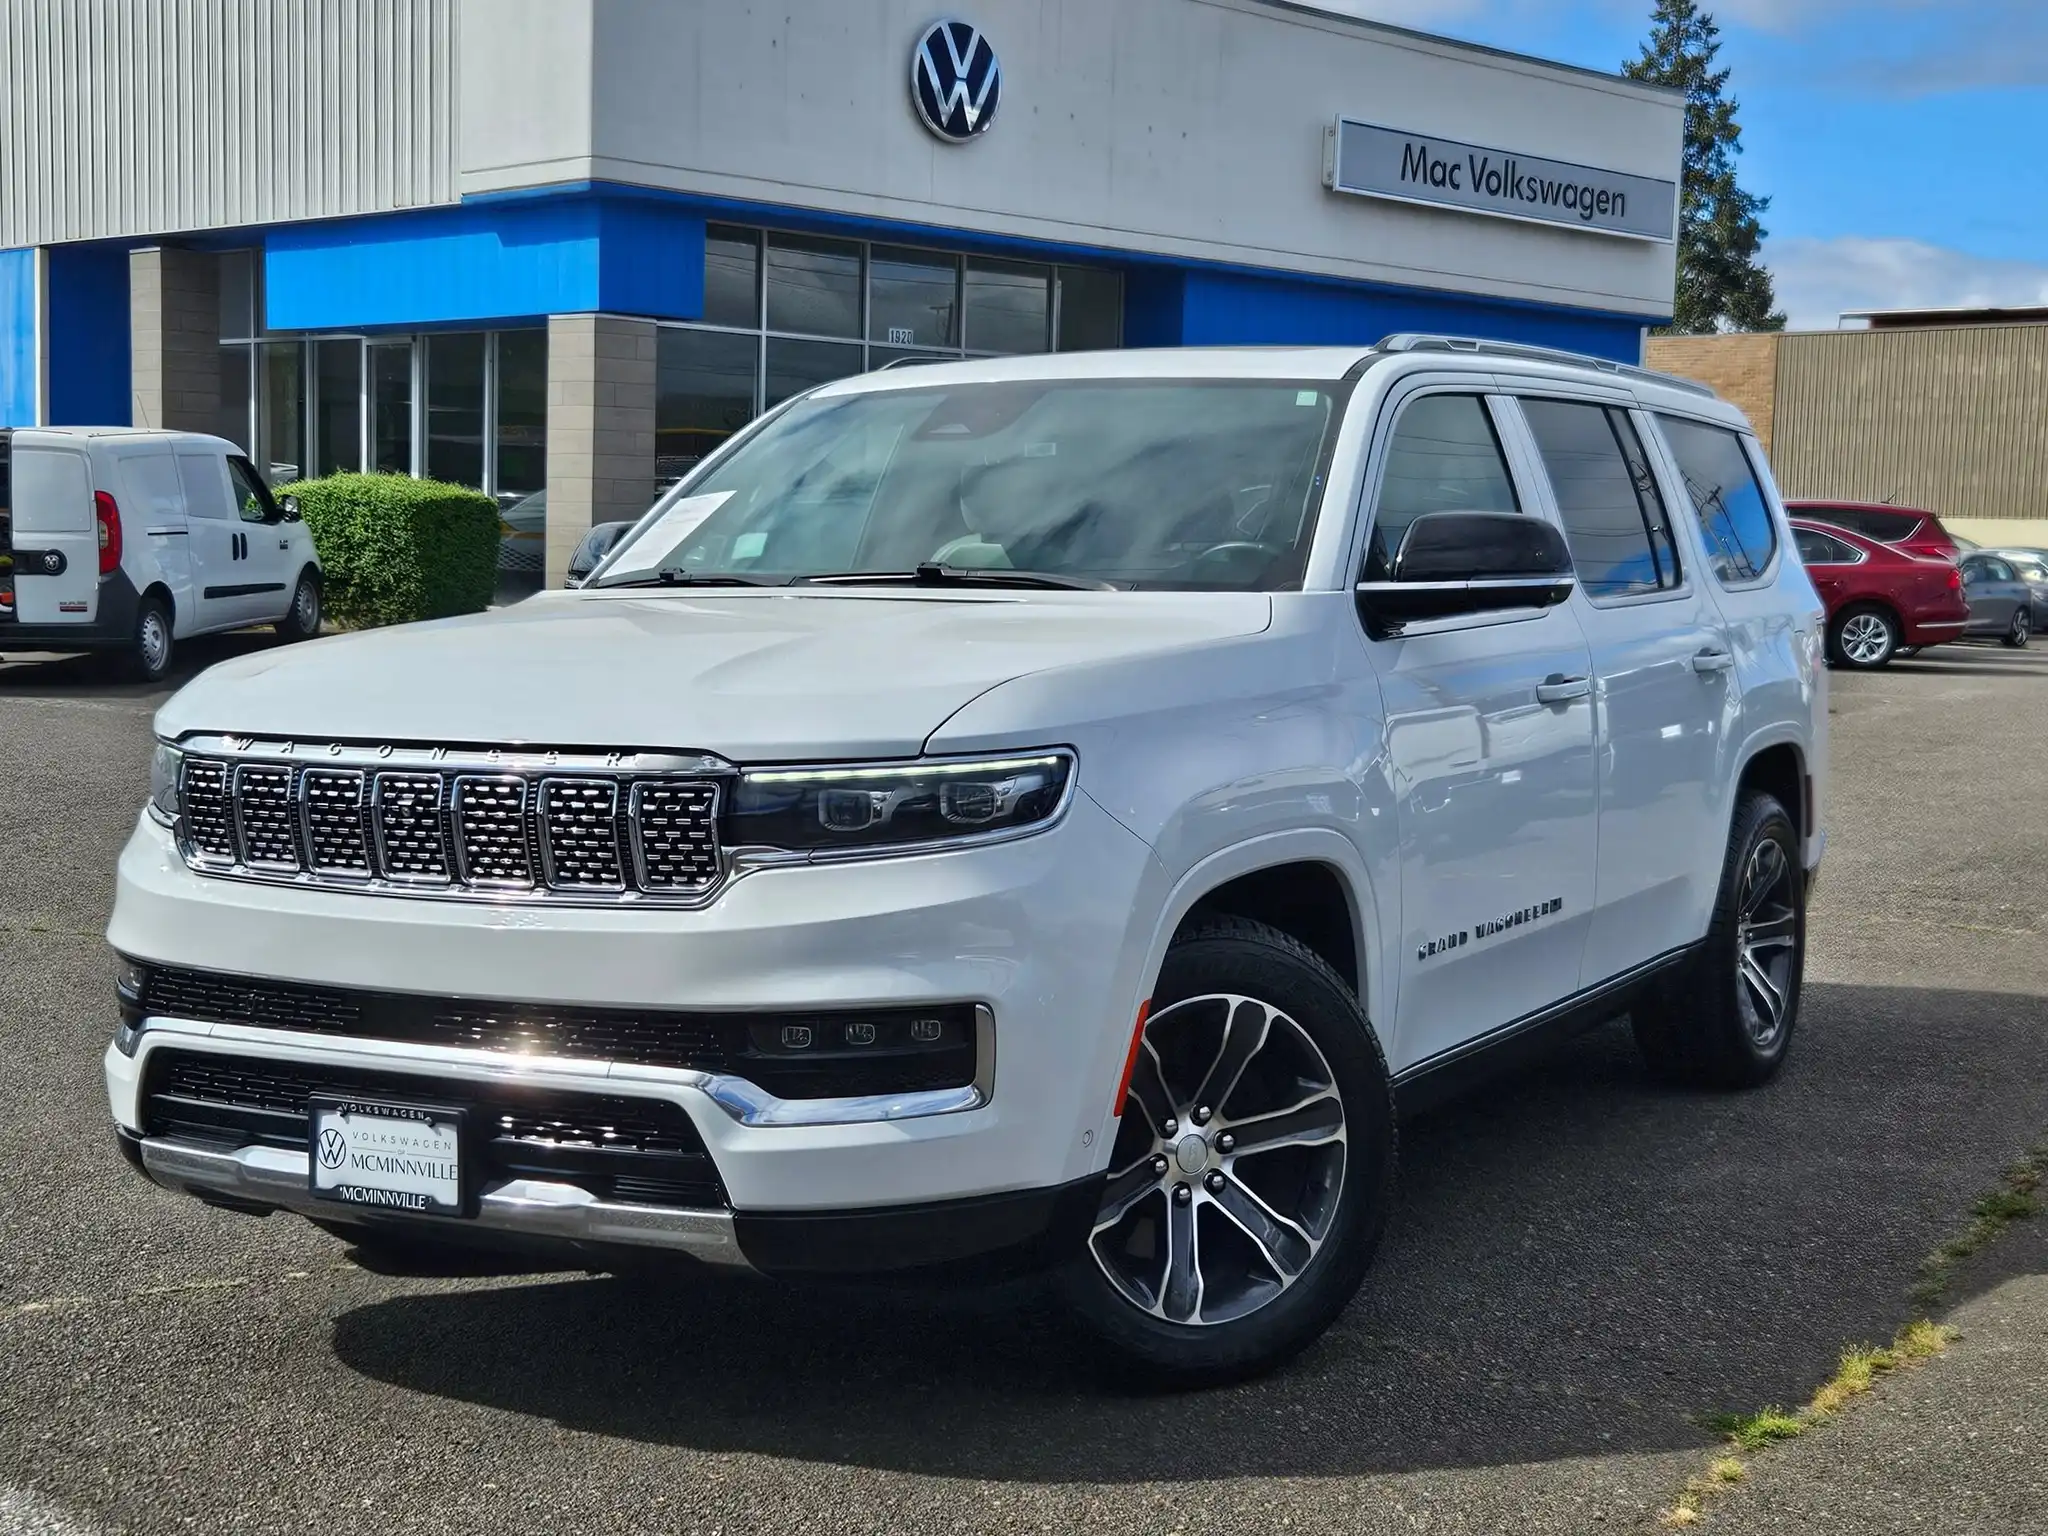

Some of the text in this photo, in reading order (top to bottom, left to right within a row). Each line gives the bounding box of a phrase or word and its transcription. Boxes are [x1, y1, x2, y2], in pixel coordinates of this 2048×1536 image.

[1400, 142, 1626, 221] Mac Volkswagen
[890, 329, 914, 345] 1920
[236, 737, 621, 767] WAGONEER
[1417, 930, 1468, 961] GRAND
[342, 1102, 425, 1120] VOLKSWAGEN
[352, 1131, 452, 1150] VOLKSWAGEN
[351, 1153, 458, 1181] MCMINNVILLE
[342, 1185, 426, 1210] MCMINNVILLE
